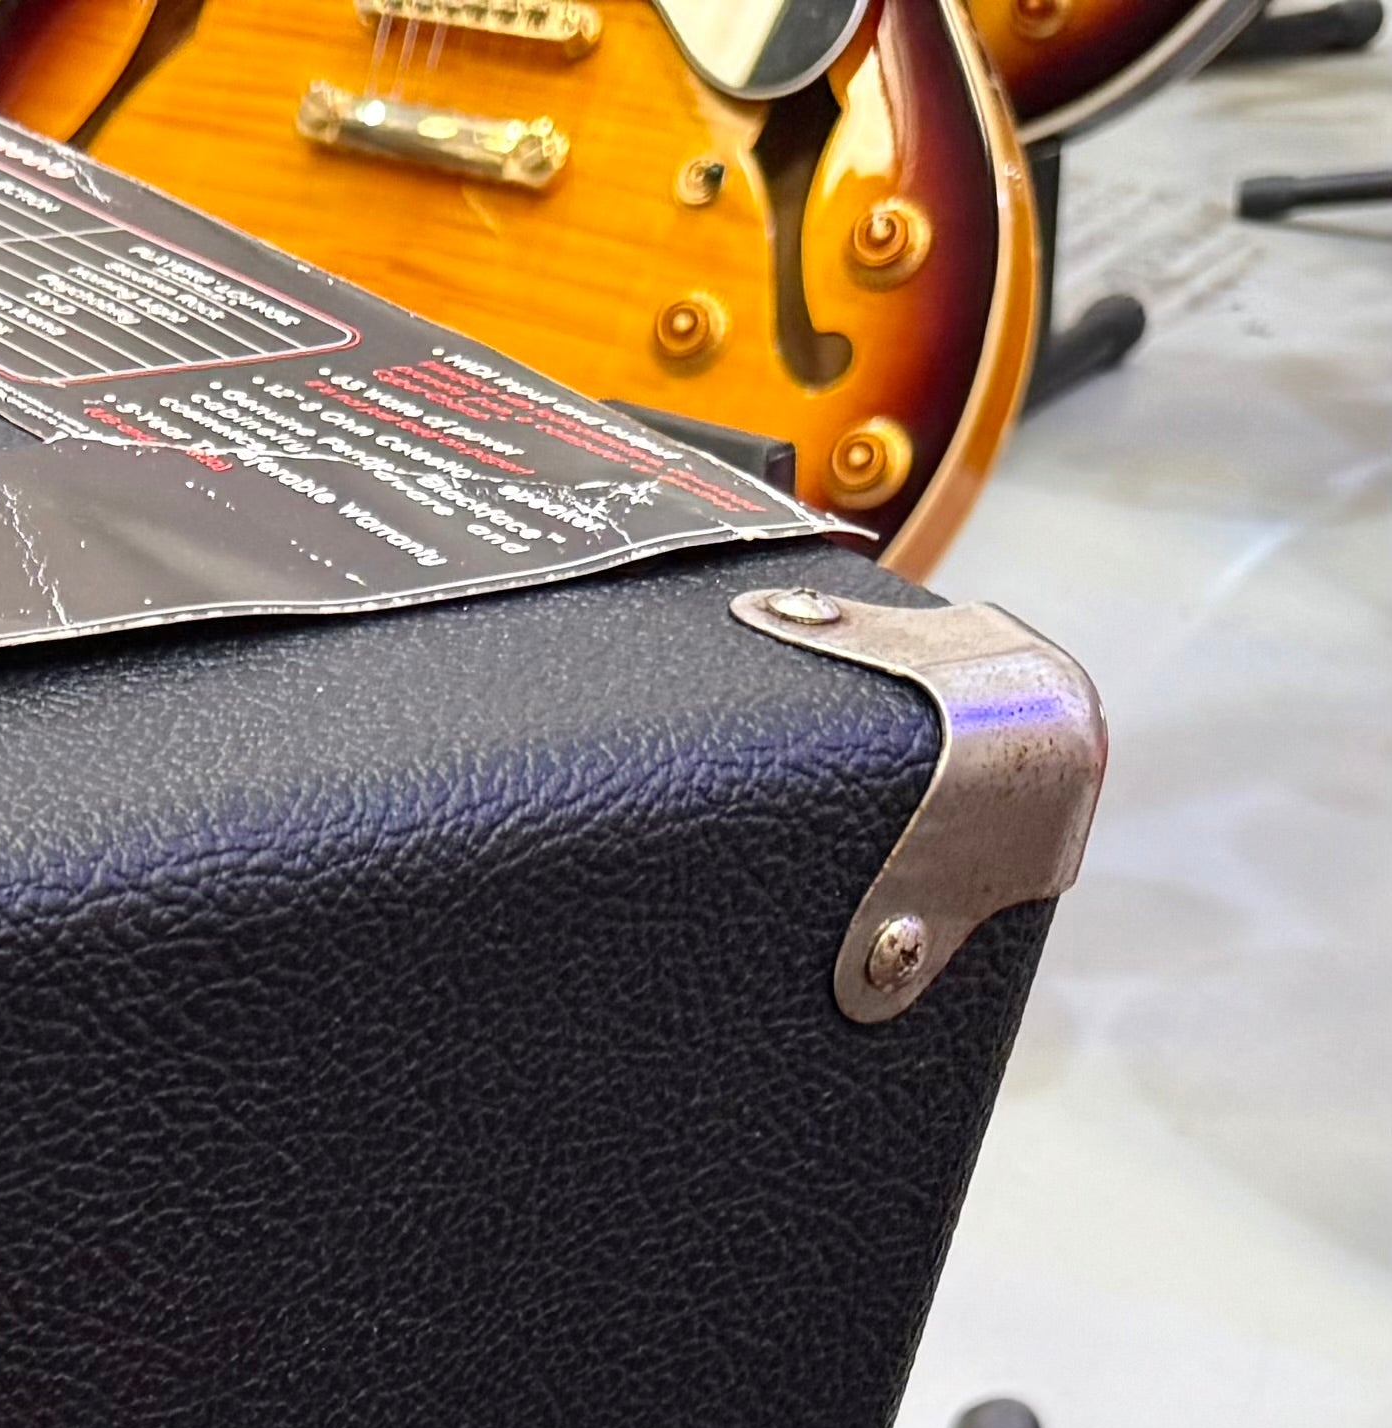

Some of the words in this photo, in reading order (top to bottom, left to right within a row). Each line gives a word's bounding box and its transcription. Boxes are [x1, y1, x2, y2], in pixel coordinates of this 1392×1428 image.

[363, 387, 425, 419] Watts
[443, 425, 526, 456] power
[444, 353, 501, 380] MIDI
[552, 402, 608, 426] and
[221, 388, 317, 438] Genuine
[316, 436, 399, 475] Fende
[416, 471, 543, 542] Blackface
[319, 411, 376, 438] Ohm
[374, 434, 481, 481] Celestio
[497, 484, 607, 533] speaker
[336, 501, 449, 569] Warranty
[465, 523, 531, 556] and
